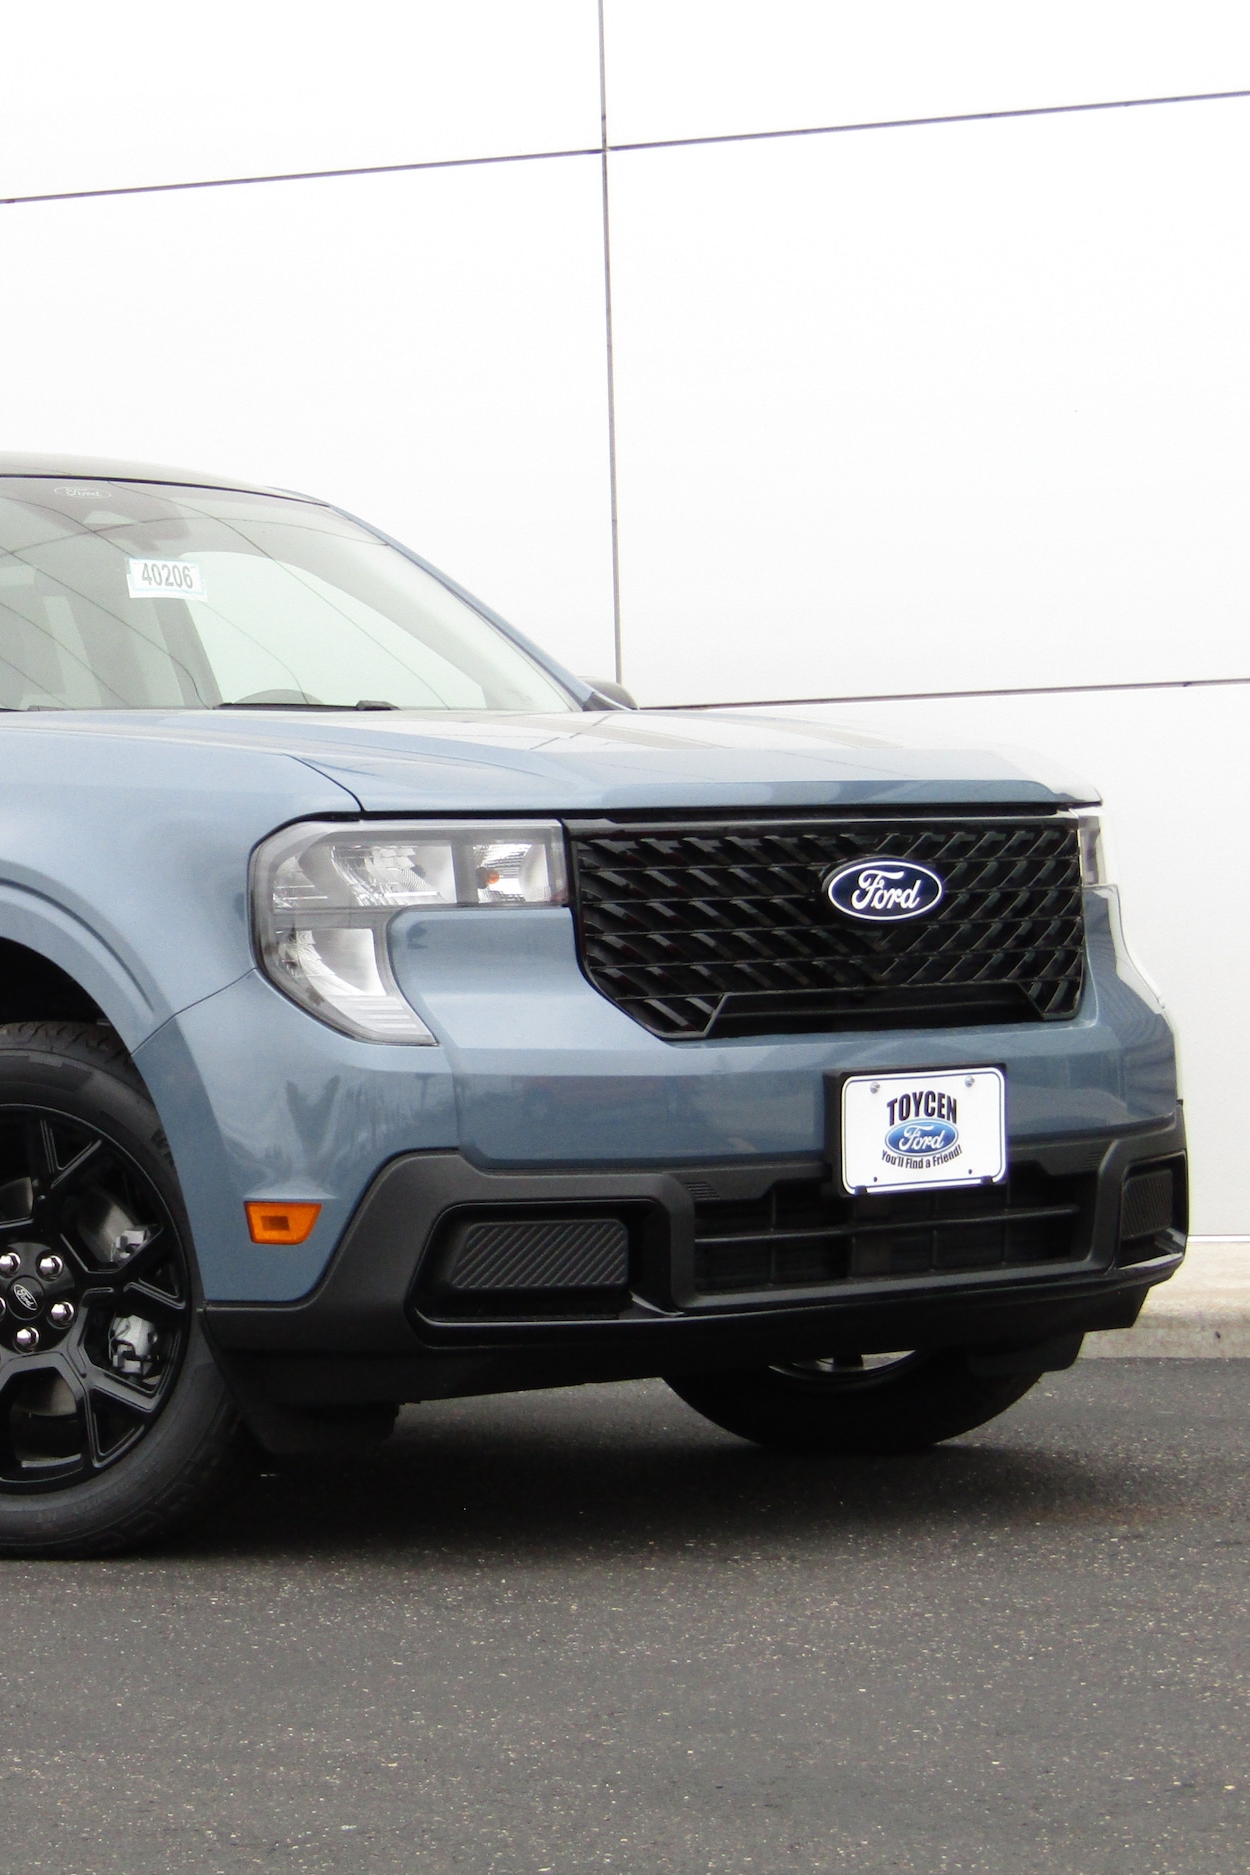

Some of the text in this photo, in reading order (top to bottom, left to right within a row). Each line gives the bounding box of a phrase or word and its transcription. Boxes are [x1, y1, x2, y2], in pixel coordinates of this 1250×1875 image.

[141, 562, 193, 589] 40206
[851, 869, 922, 910] Ford
[886, 1090, 958, 1127] TOYCEN
[898, 1124, 945, 1151] Ford
[881, 1143, 963, 1169] You'll Find a Friend!
